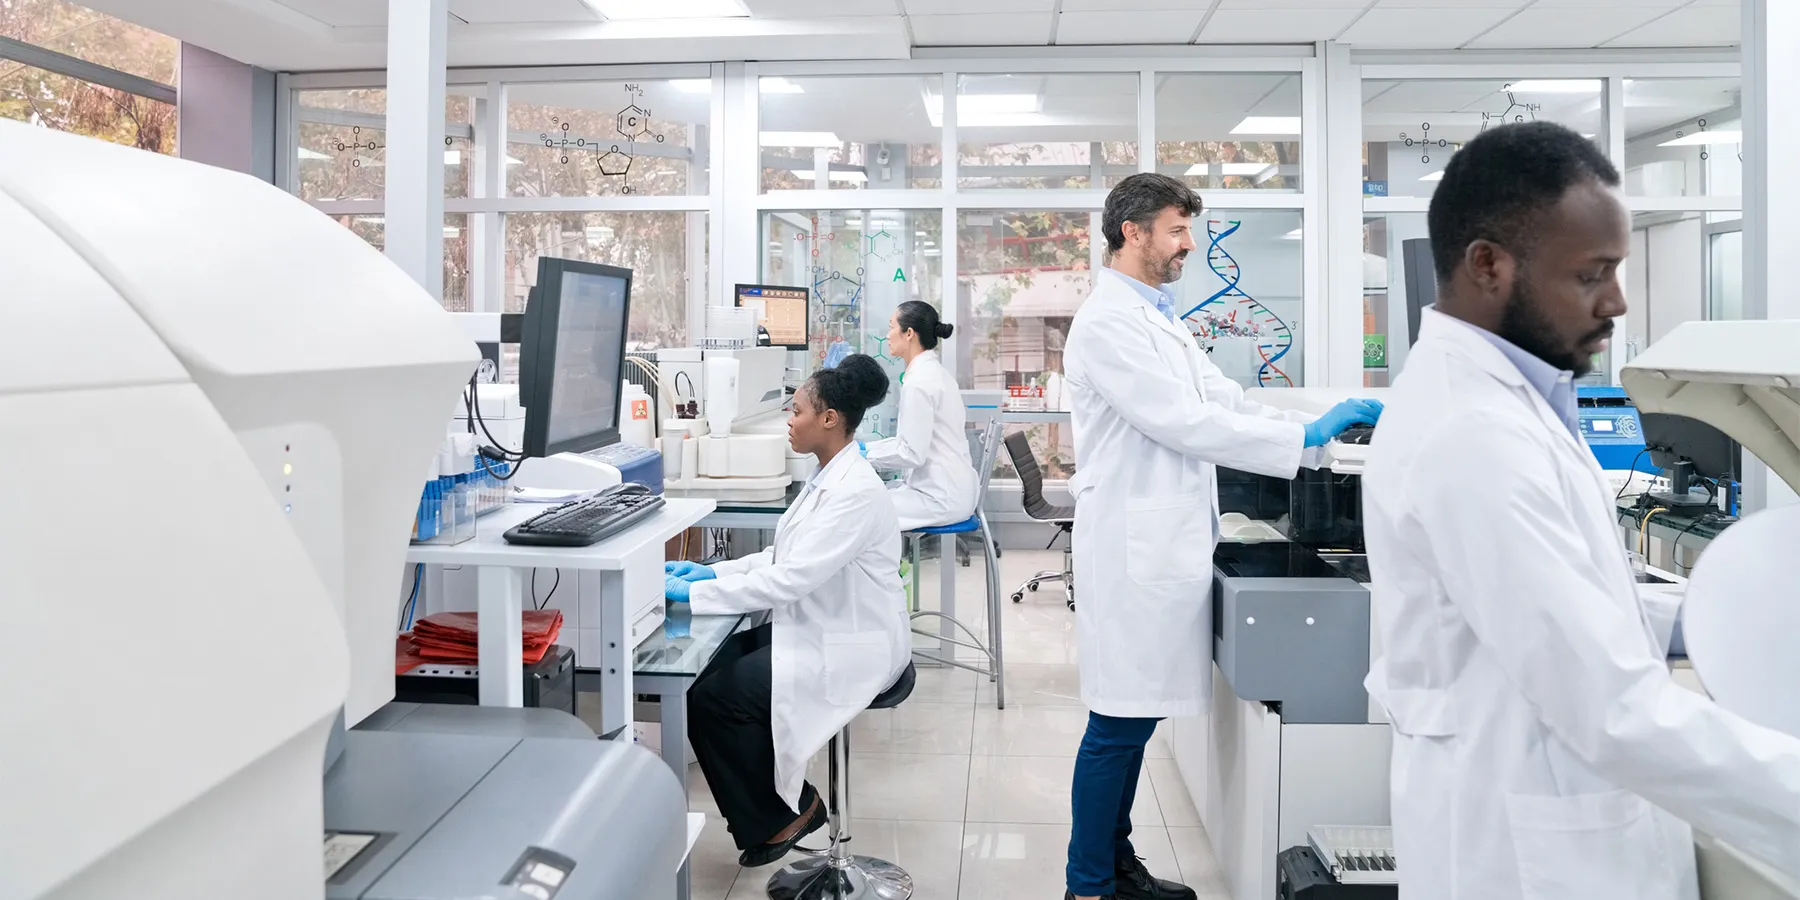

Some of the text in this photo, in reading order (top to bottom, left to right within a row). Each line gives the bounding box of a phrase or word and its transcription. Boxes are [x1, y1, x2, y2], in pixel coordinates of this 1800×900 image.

[1525, 103, 1541, 112] NH
[644, 109, 652, 117] N
[1482, 112, 1490, 120] N
[627, 117, 637, 127] C
[1514, 114, 1524, 123] G
[353, 126, 361, 135] O
[562, 122, 570, 132] O
[1422, 122, 1431, 131] O
[656, 134, 665, 143] O
[611, 144, 619, 154] O
[353, 158, 361, 168] O
[561, 155, 569, 164] O
[1421, 154, 1430, 164] O
[622, 185, 637, 195] OH
[832, 270, 841, 280] O
[856, 267, 865, 276] O
[893, 267, 907, 282] A
